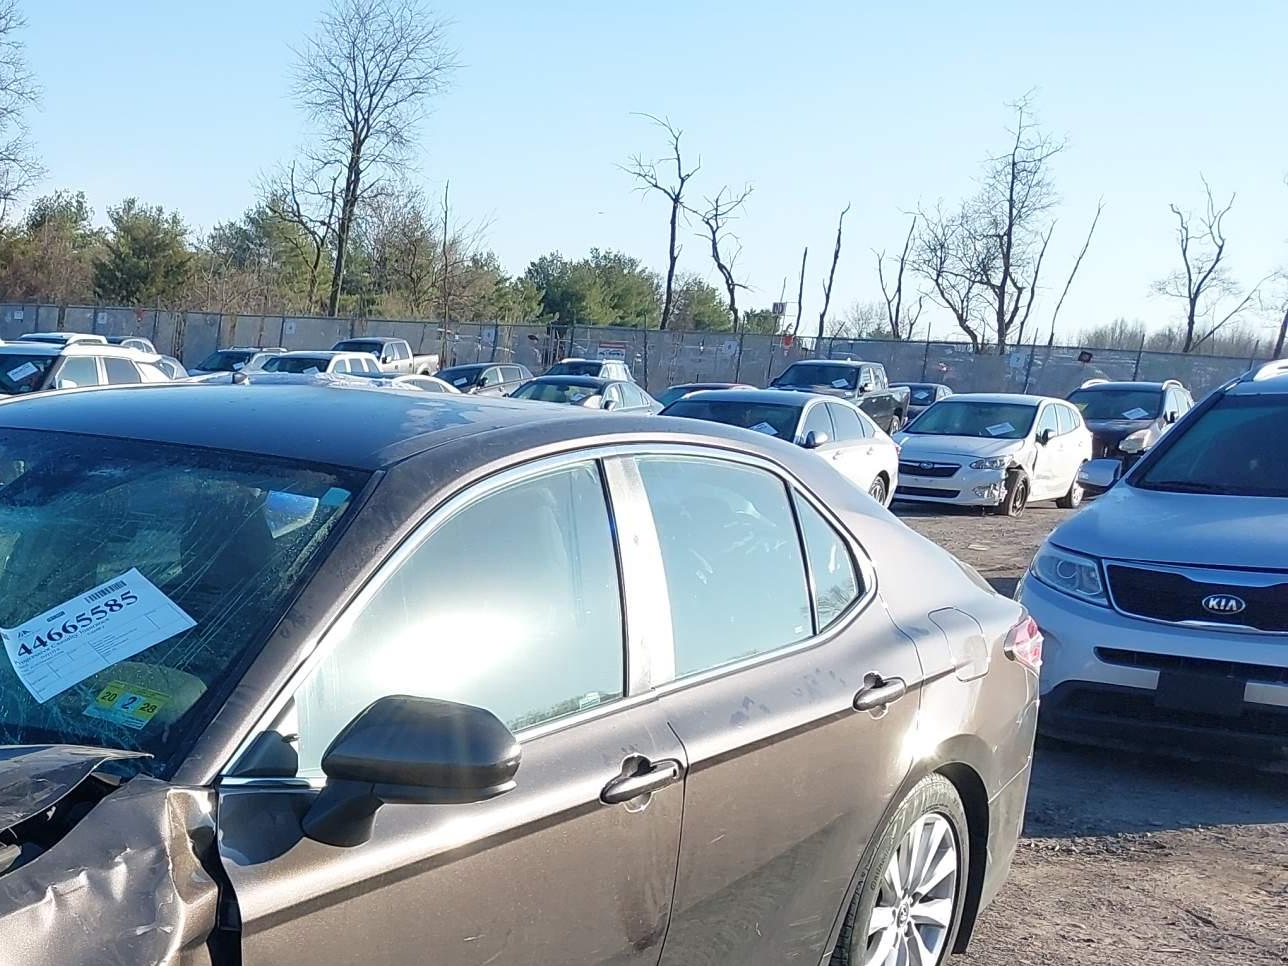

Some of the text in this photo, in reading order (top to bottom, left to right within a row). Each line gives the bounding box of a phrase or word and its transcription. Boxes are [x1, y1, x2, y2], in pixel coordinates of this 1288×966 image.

[1209, 598, 1238, 610] KIA
[17, 590, 138, 656] 44665585
[100, 691, 158, 714] 20 2 28
